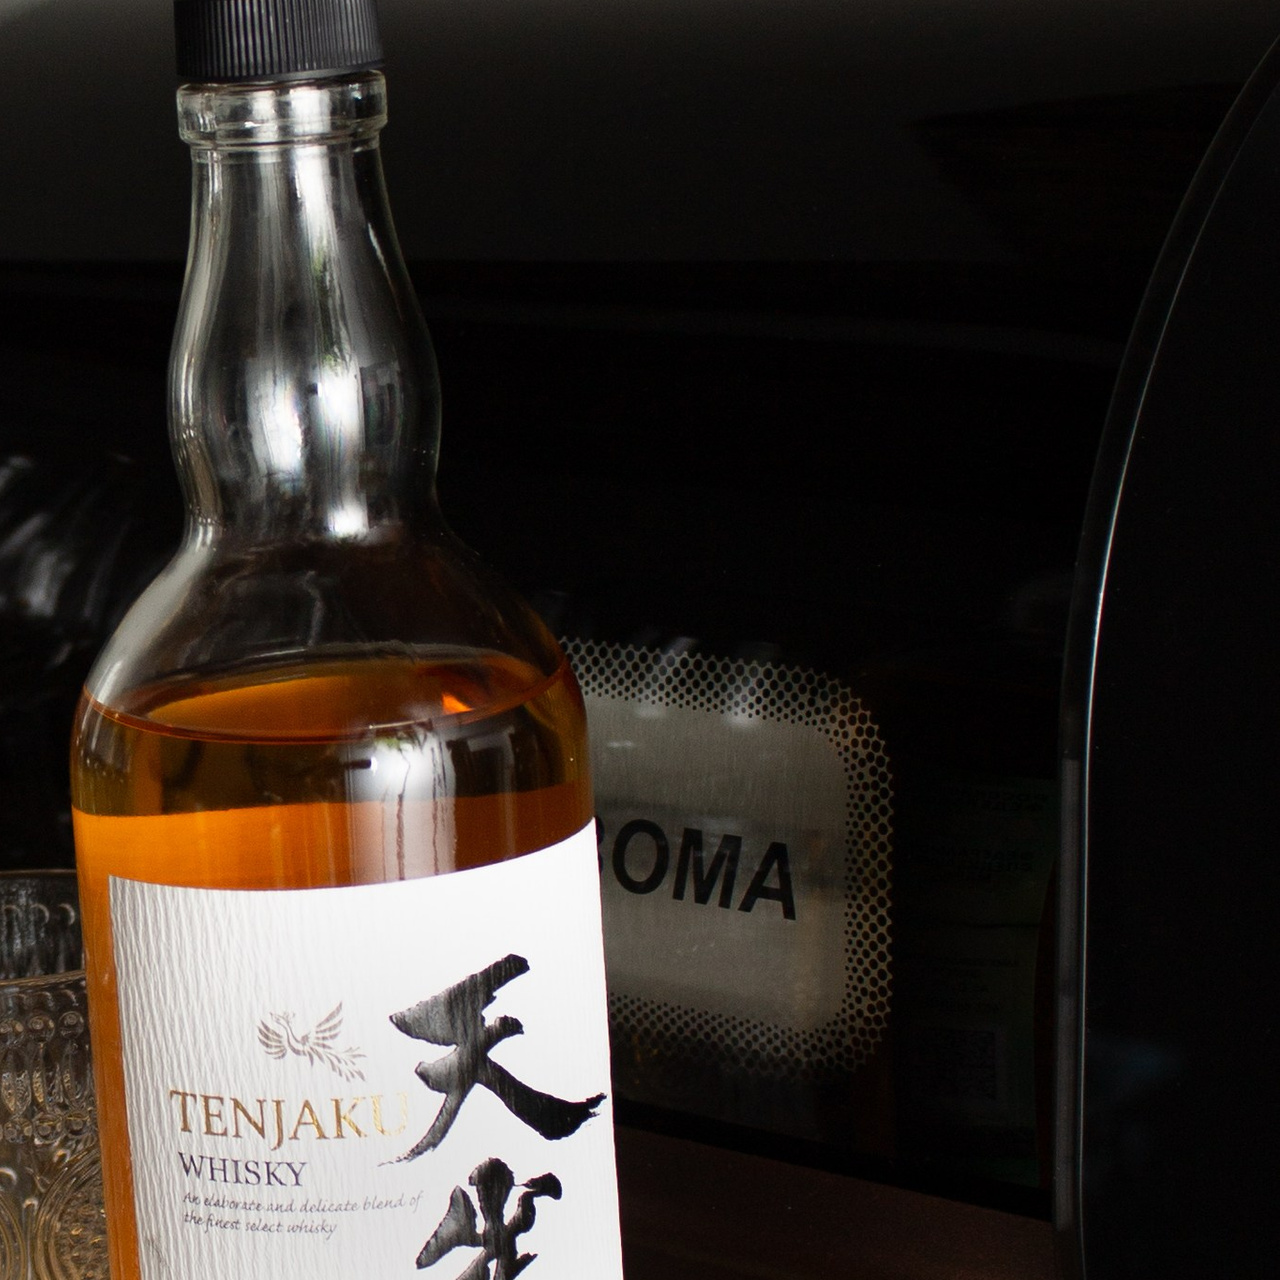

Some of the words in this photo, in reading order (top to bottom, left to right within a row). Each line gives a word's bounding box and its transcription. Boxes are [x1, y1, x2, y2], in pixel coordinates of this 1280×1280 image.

[596, 817, 797, 921] OMA
[169, 1089, 409, 1152] TENJAKU
[177, 1151, 307, 1187] WHISKY
[183, 1192, 201, 1205] An
[204, 1193, 264, 1212] elaborate
[268, 1196, 295, 1213] and
[299, 1196, 359, 1214] delicate
[363, 1192, 405, 1211] blend
[409, 1190, 424, 1214] of
[184, 1210, 204, 1225] the
[204, 1212, 240, 1234] finest
[245, 1216, 282, 1233] select
[286, 1218, 338, 1240] whisky
